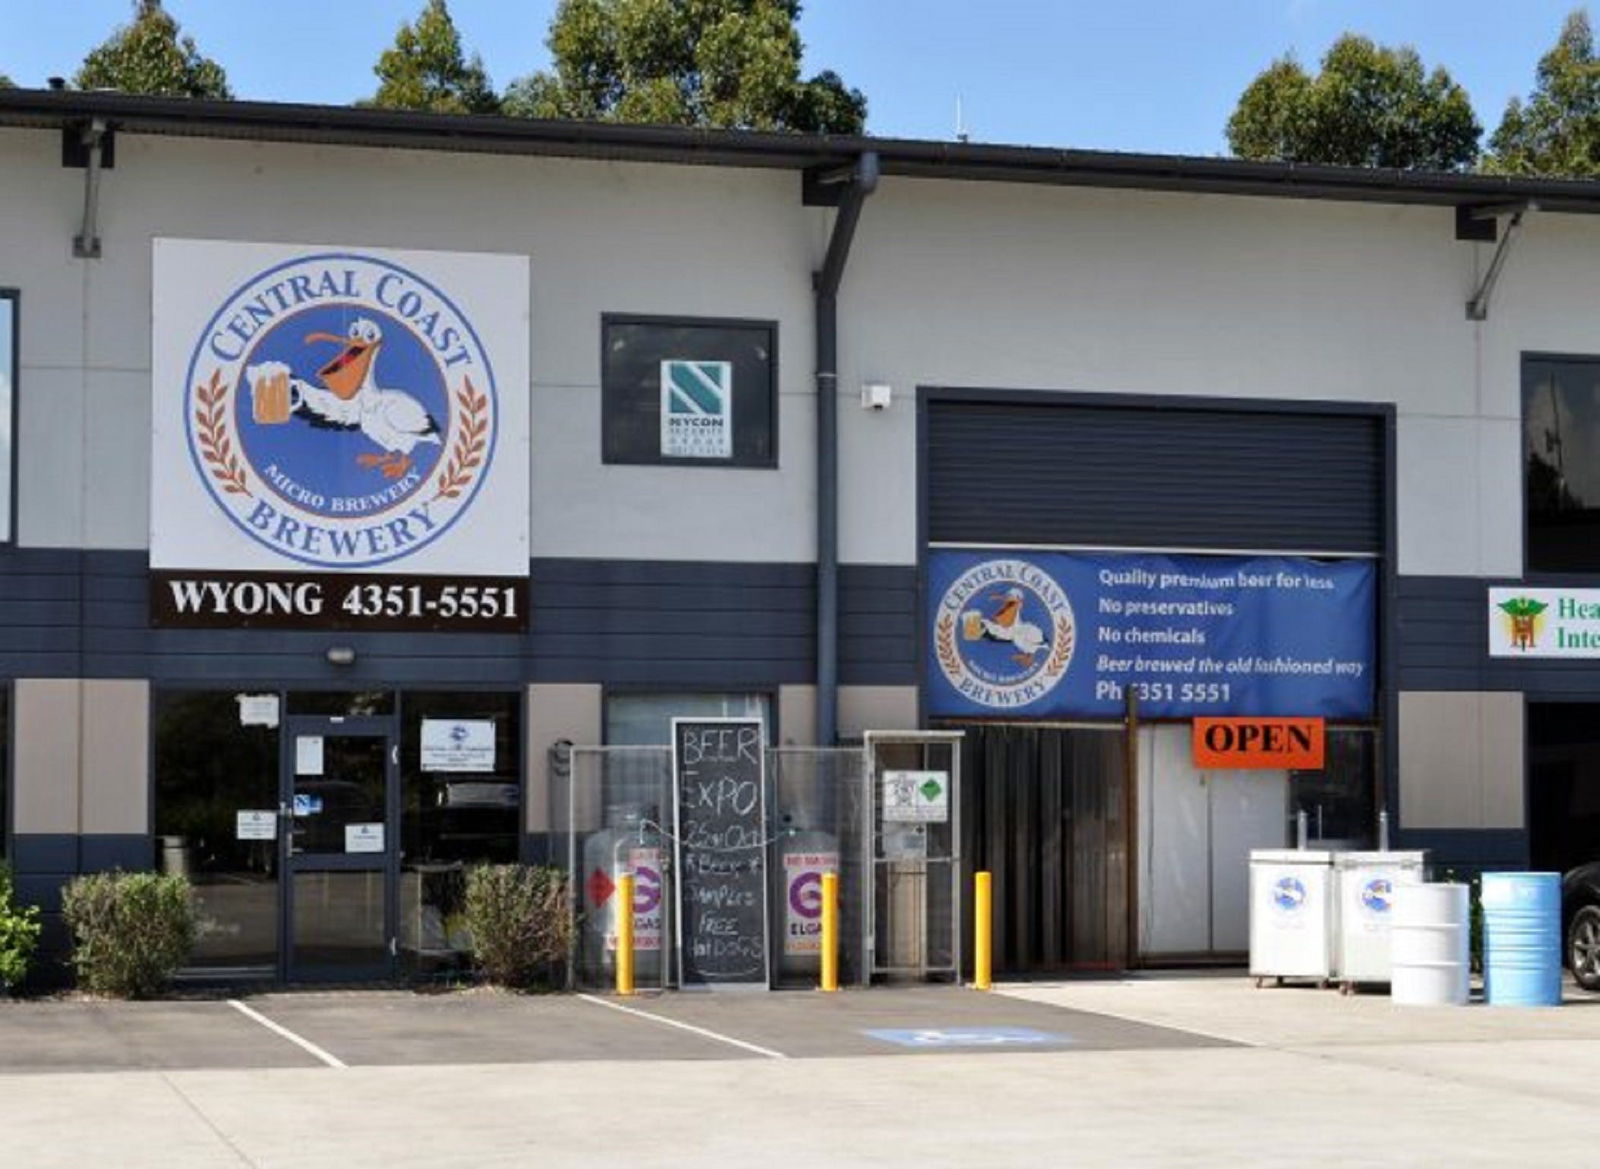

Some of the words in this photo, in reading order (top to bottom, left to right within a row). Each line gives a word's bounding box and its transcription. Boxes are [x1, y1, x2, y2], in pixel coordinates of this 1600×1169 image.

[209, 270, 360, 363] CENTRAL
[375, 273, 473, 368] COAST
[264, 465, 325, 508] MICRO
[332, 467, 422, 513] BREWERY
[246, 500, 439, 557] BREWERY
[944, 565, 1017, 610] CENTRAL
[1099, 569, 1156, 589] Quality
[1160, 573, 1235, 589] premium
[1238, 571, 1272, 588] beer
[1276, 572, 1302, 588] for
[168, 579, 323, 615] WYONG
[342, 585, 518, 618] 4351-5551
[1099, 598, 1122, 613] No
[1125, 600, 1233, 616] preservatives
[1558, 598, 1600, 619] Hea
[1098, 626, 1121, 641] No
[1124, 627, 1206, 644] chemicals
[1558, 627, 1600, 648] Inte
[1096, 654, 1133, 672] Beer
[1134, 655, 1195, 672] brewed
[1198, 658, 1224, 673] the
[1225, 657, 1252, 673] old
[1254, 658, 1334, 674] fashioned
[1335, 661, 1364, 678] way
[959, 676, 1045, 704] BREWERY
[1096, 680, 1123, 700] Ph
[1180, 683, 1230, 702] 5551
[683, 727, 758, 765] BEER
[1205, 724, 1313, 753] OPEN
